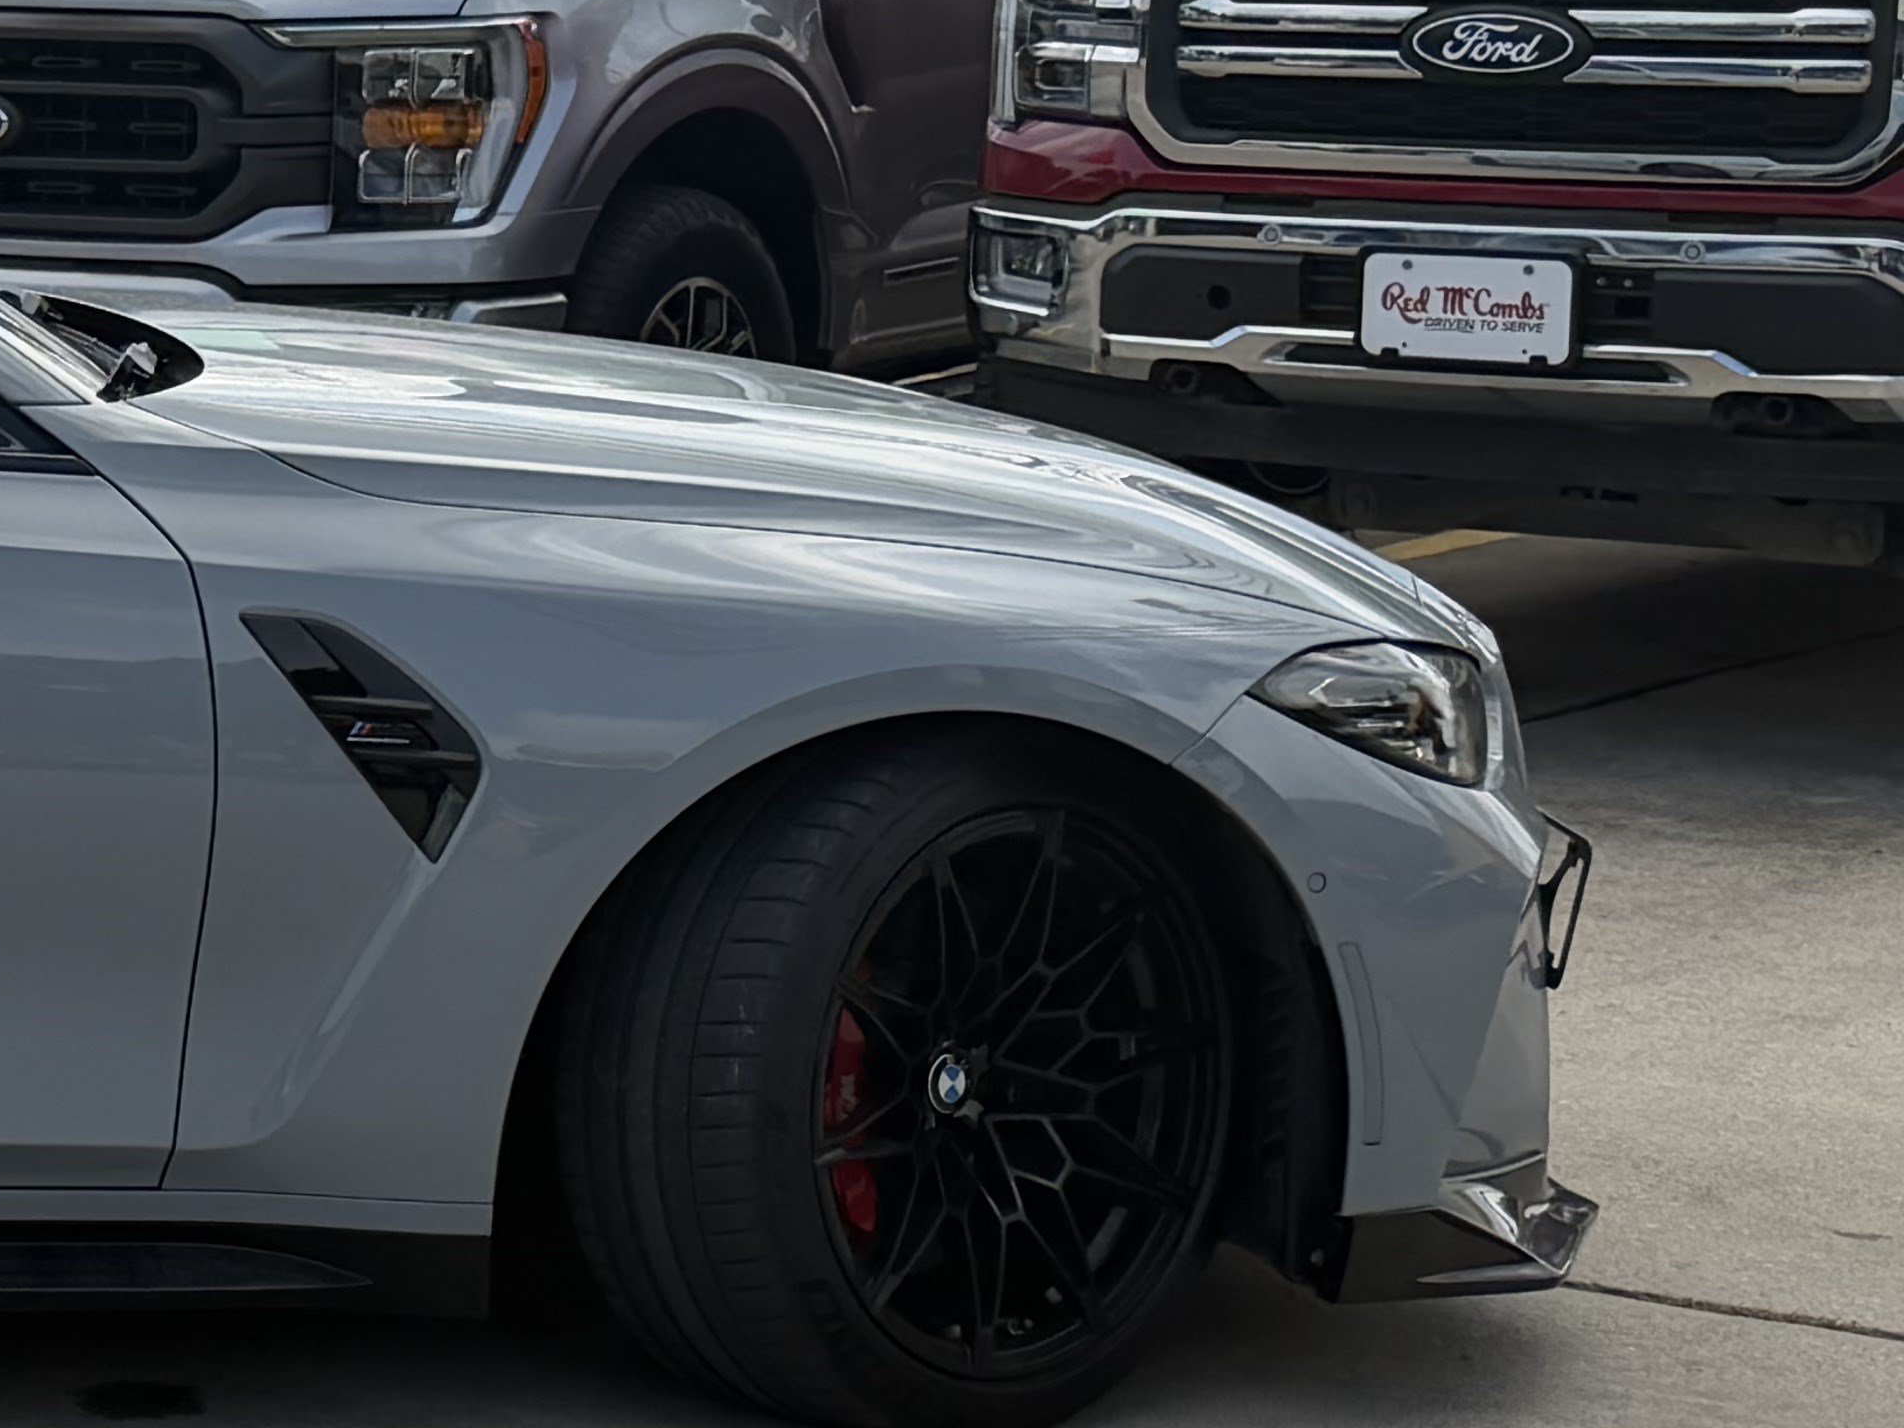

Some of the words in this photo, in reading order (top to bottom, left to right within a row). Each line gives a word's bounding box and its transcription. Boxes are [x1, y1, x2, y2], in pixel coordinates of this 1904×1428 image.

[1443, 21, 1543, 63] Ford
[1382, 282, 1430, 324] Red
[1436, 286, 1546, 320] McCombs
[1424, 317, 1475, 331] DRIVEN
[1480, 320, 1498, 332] TO
[1501, 322, 1545, 334] SERVE
